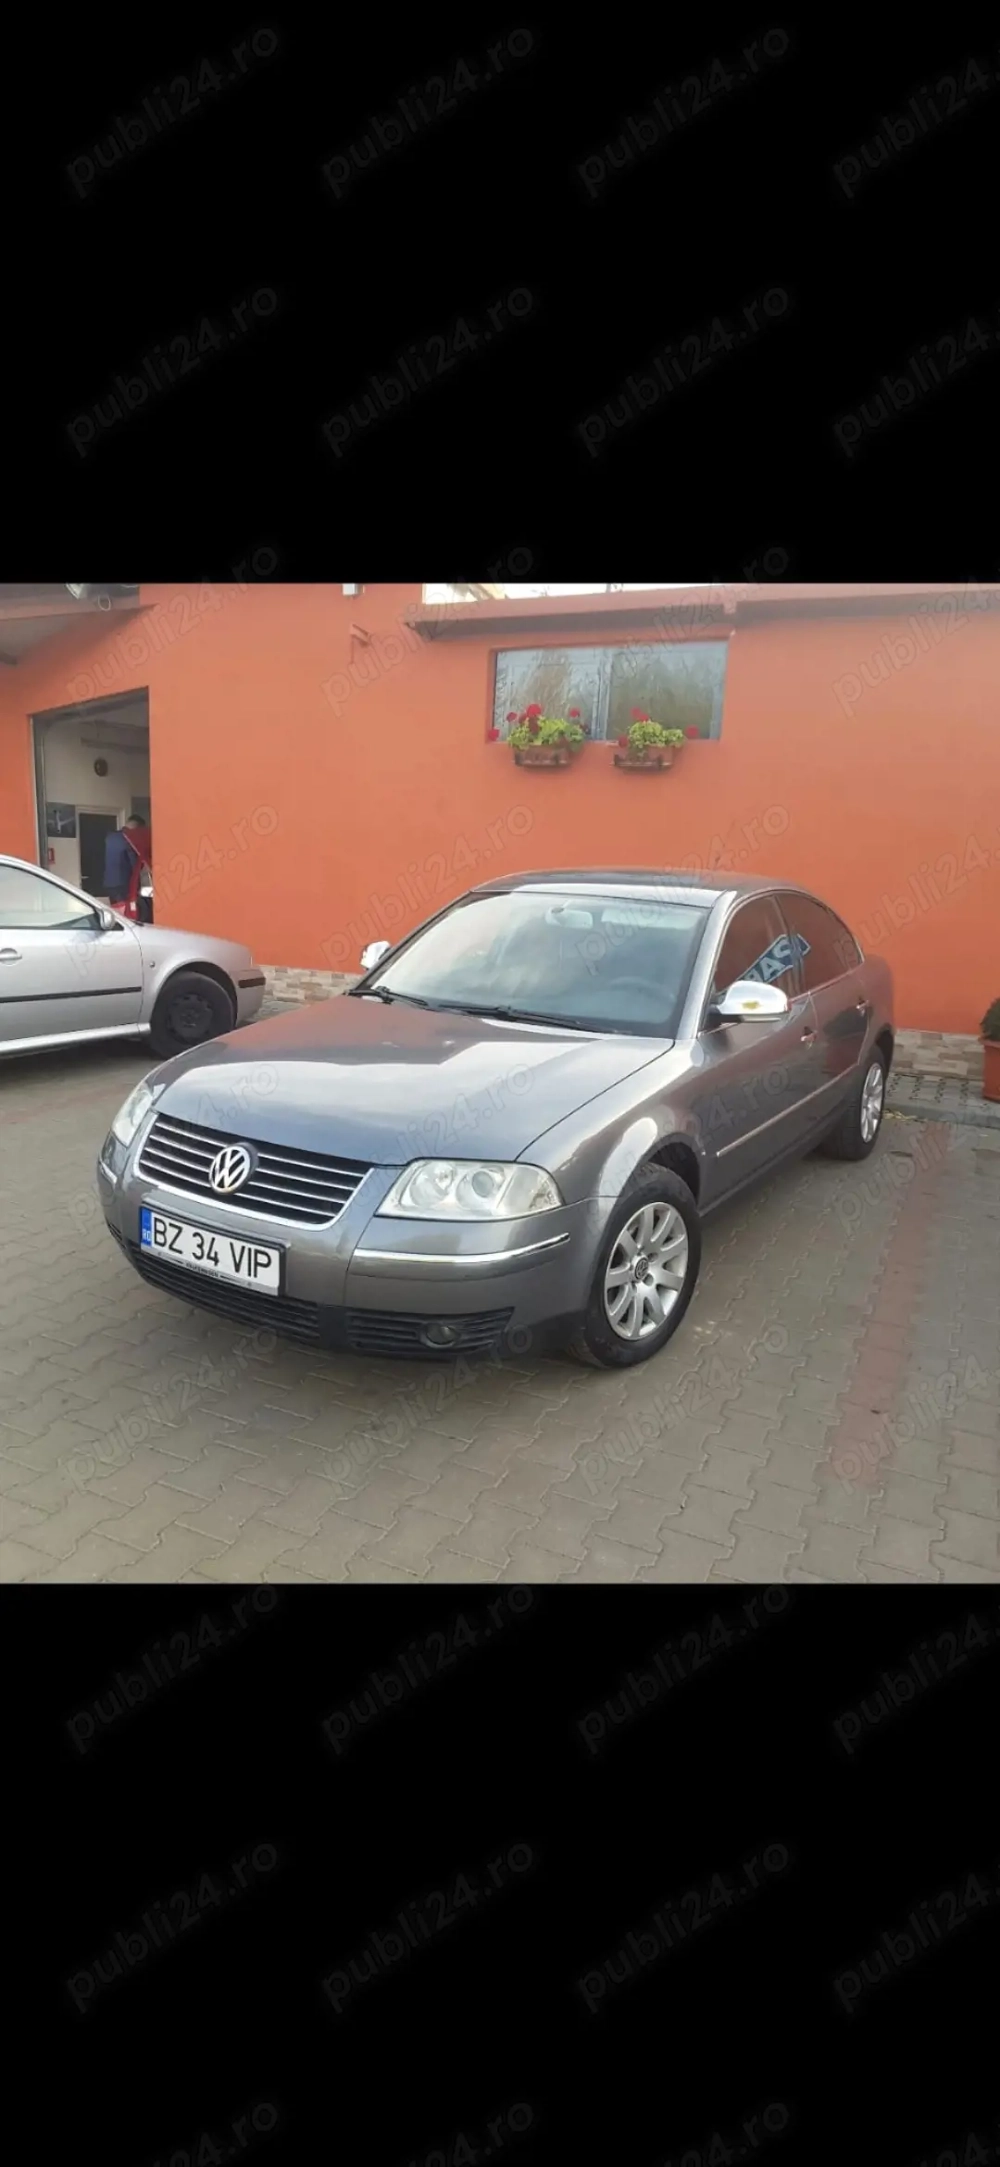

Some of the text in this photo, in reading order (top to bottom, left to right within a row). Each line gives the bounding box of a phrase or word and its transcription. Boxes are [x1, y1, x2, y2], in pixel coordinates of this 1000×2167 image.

[142, 1228, 152, 1242] RO
[153, 1216, 272, 1279] BZ 34 VIP
